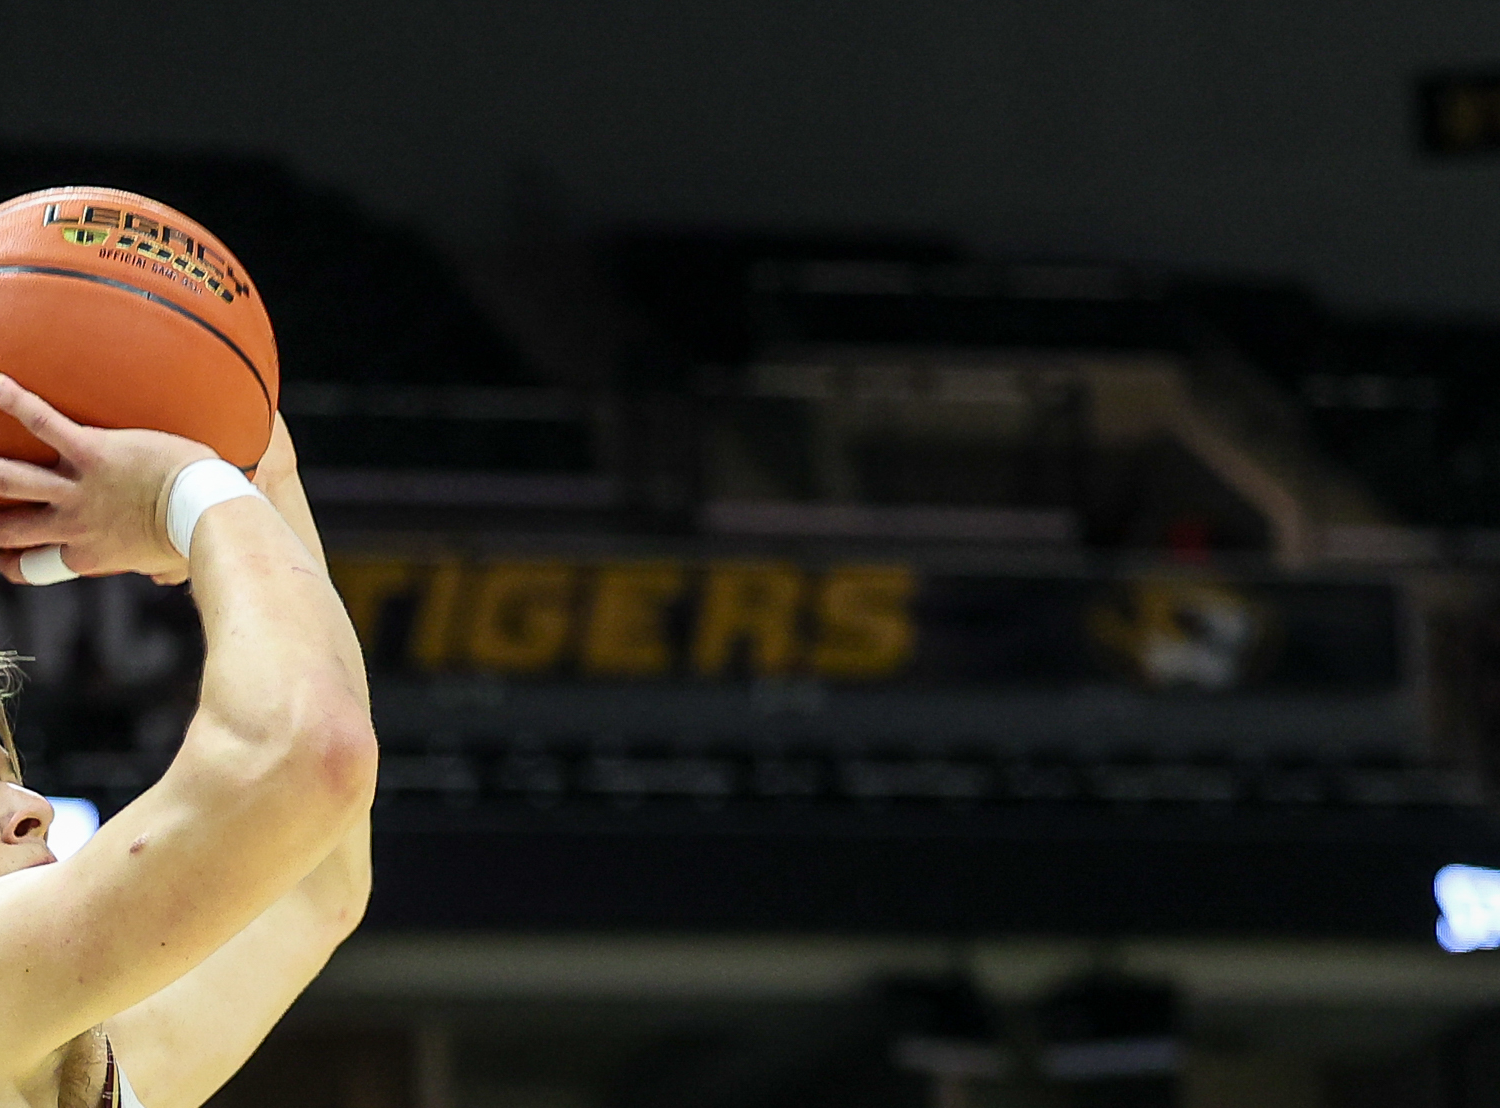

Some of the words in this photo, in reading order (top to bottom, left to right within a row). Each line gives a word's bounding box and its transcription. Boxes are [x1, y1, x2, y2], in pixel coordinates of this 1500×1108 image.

[43, 203, 250, 299] LEGACY
[99, 248, 146, 269] OFFICIAL
[328, 557, 917, 678] TIGERS
